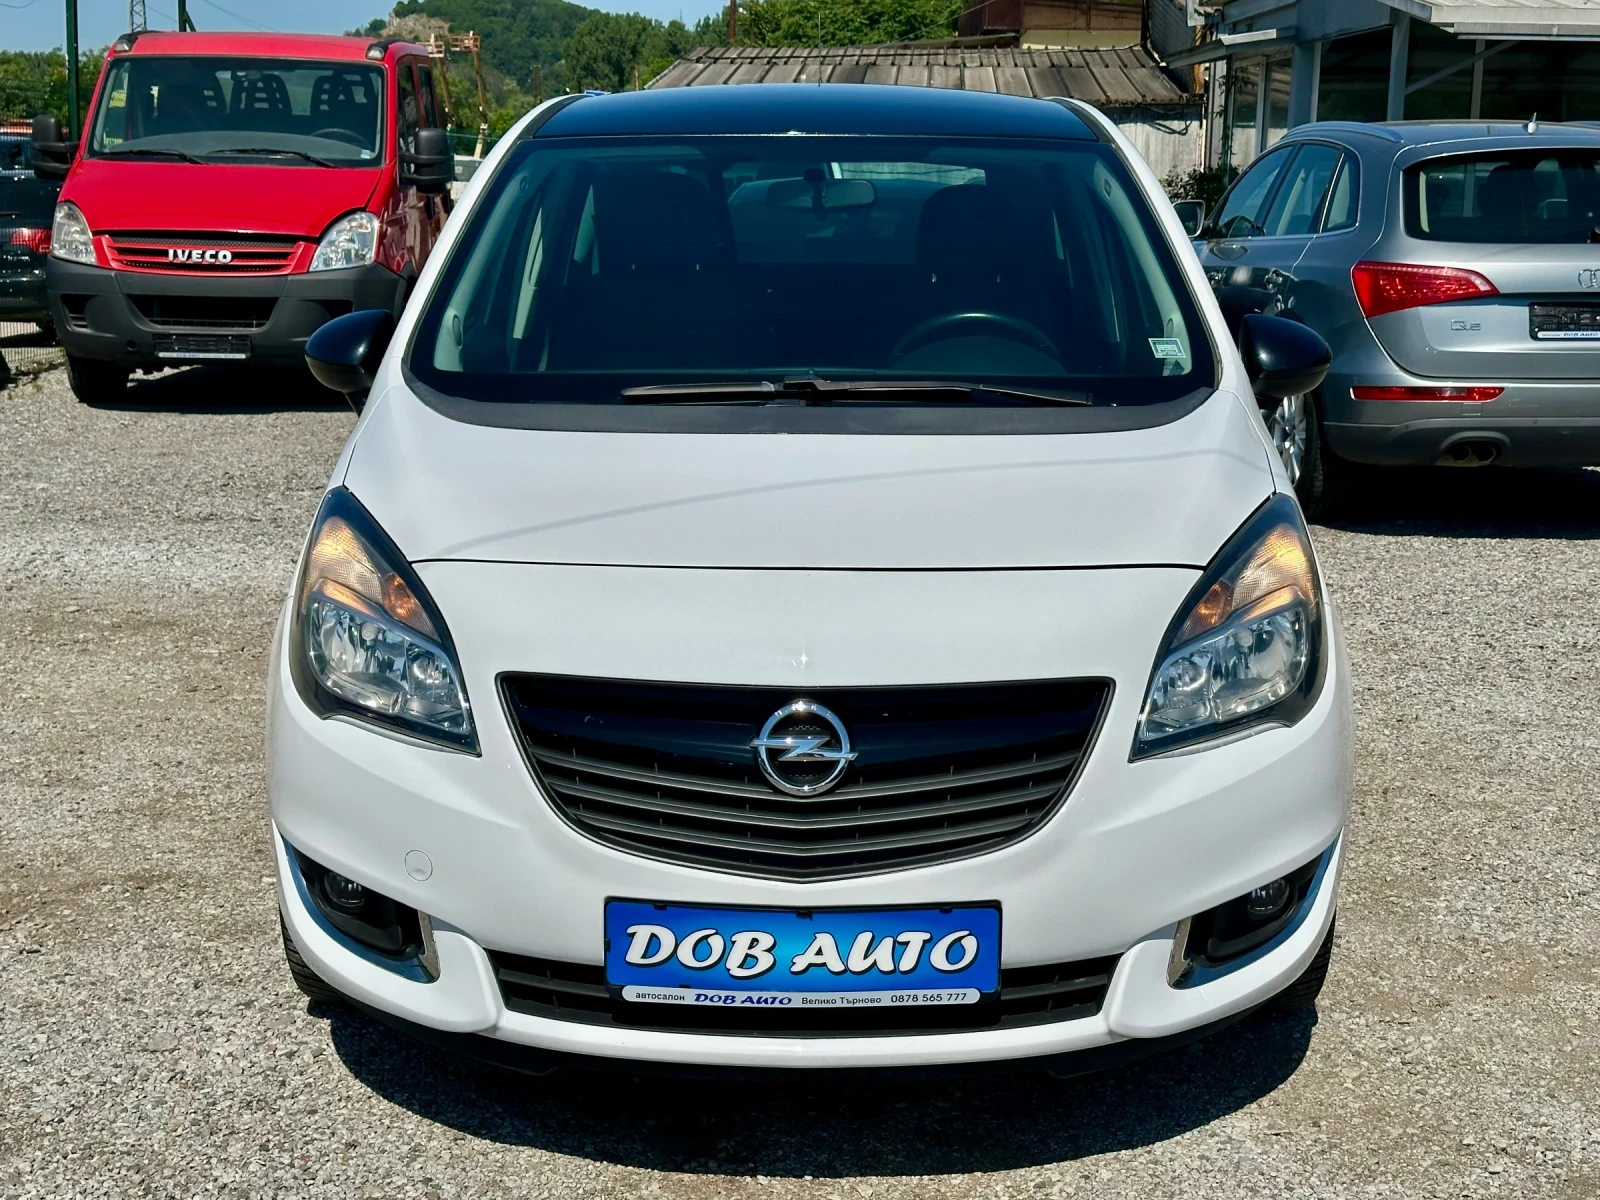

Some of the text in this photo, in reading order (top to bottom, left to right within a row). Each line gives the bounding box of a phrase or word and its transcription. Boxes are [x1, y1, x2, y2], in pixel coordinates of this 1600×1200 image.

[168, 249, 232, 264] IVECO
[625, 924, 979, 978] DOB AUTO
[635, 991, 685, 1002] автосалон
[694, 993, 793, 1006] DOB AUTO
[801, 996, 882, 1006] Велико Търново
[890, 992, 967, 1003] 0878 565 777
